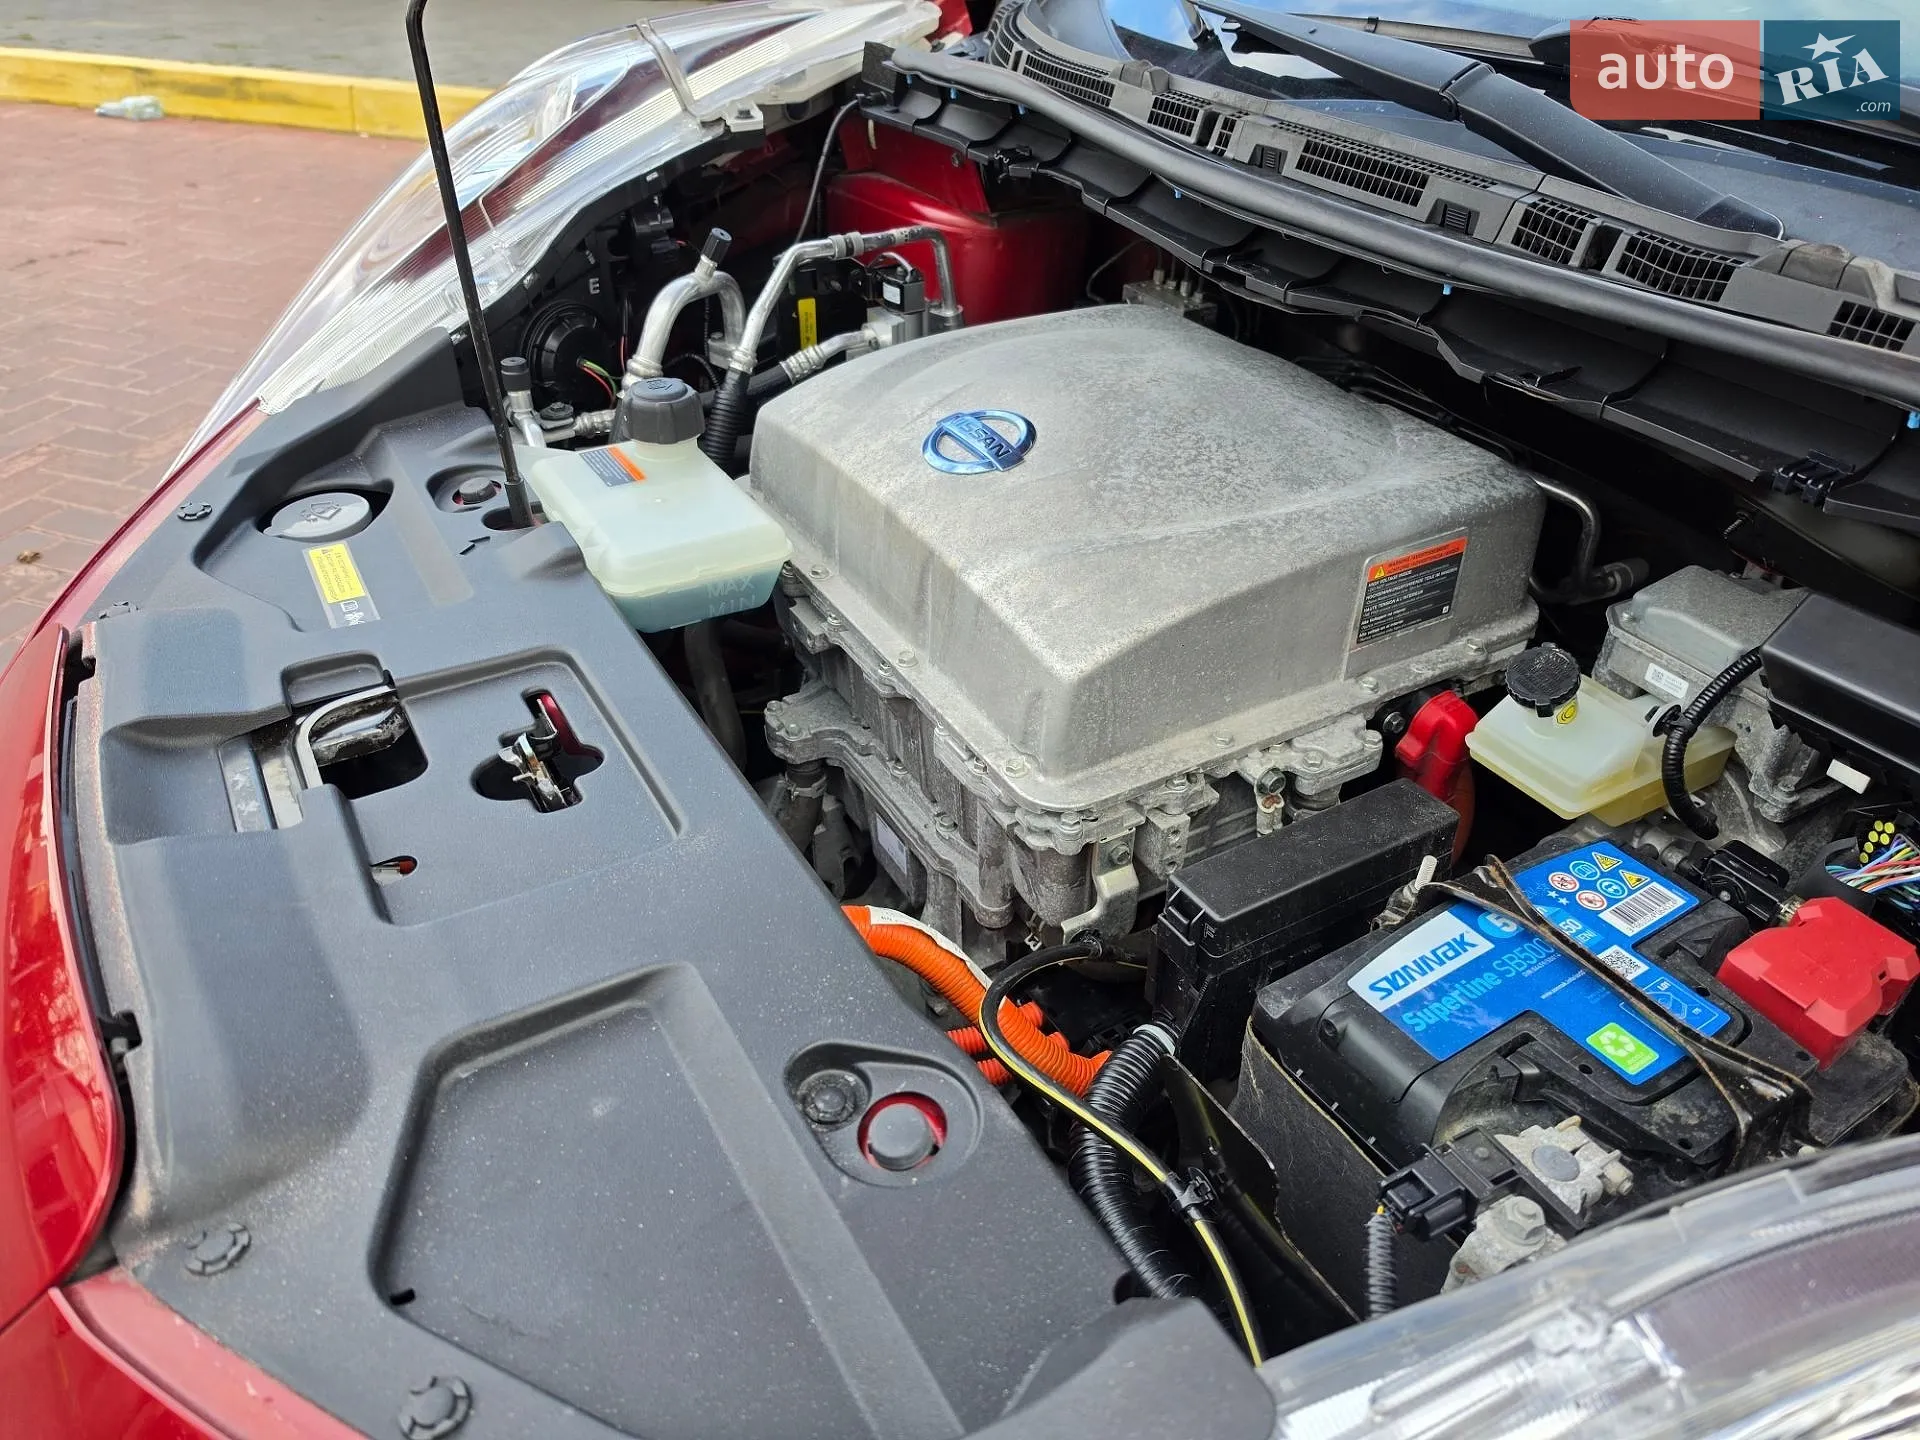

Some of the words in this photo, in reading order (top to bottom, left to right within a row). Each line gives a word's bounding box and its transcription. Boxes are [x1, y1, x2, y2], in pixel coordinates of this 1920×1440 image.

[704, 575, 756, 598] MAX
[705, 594, 756, 617] MIN
[1402, 972, 1502, 1032] Superline
[1492, 938, 1555, 978] SB500
